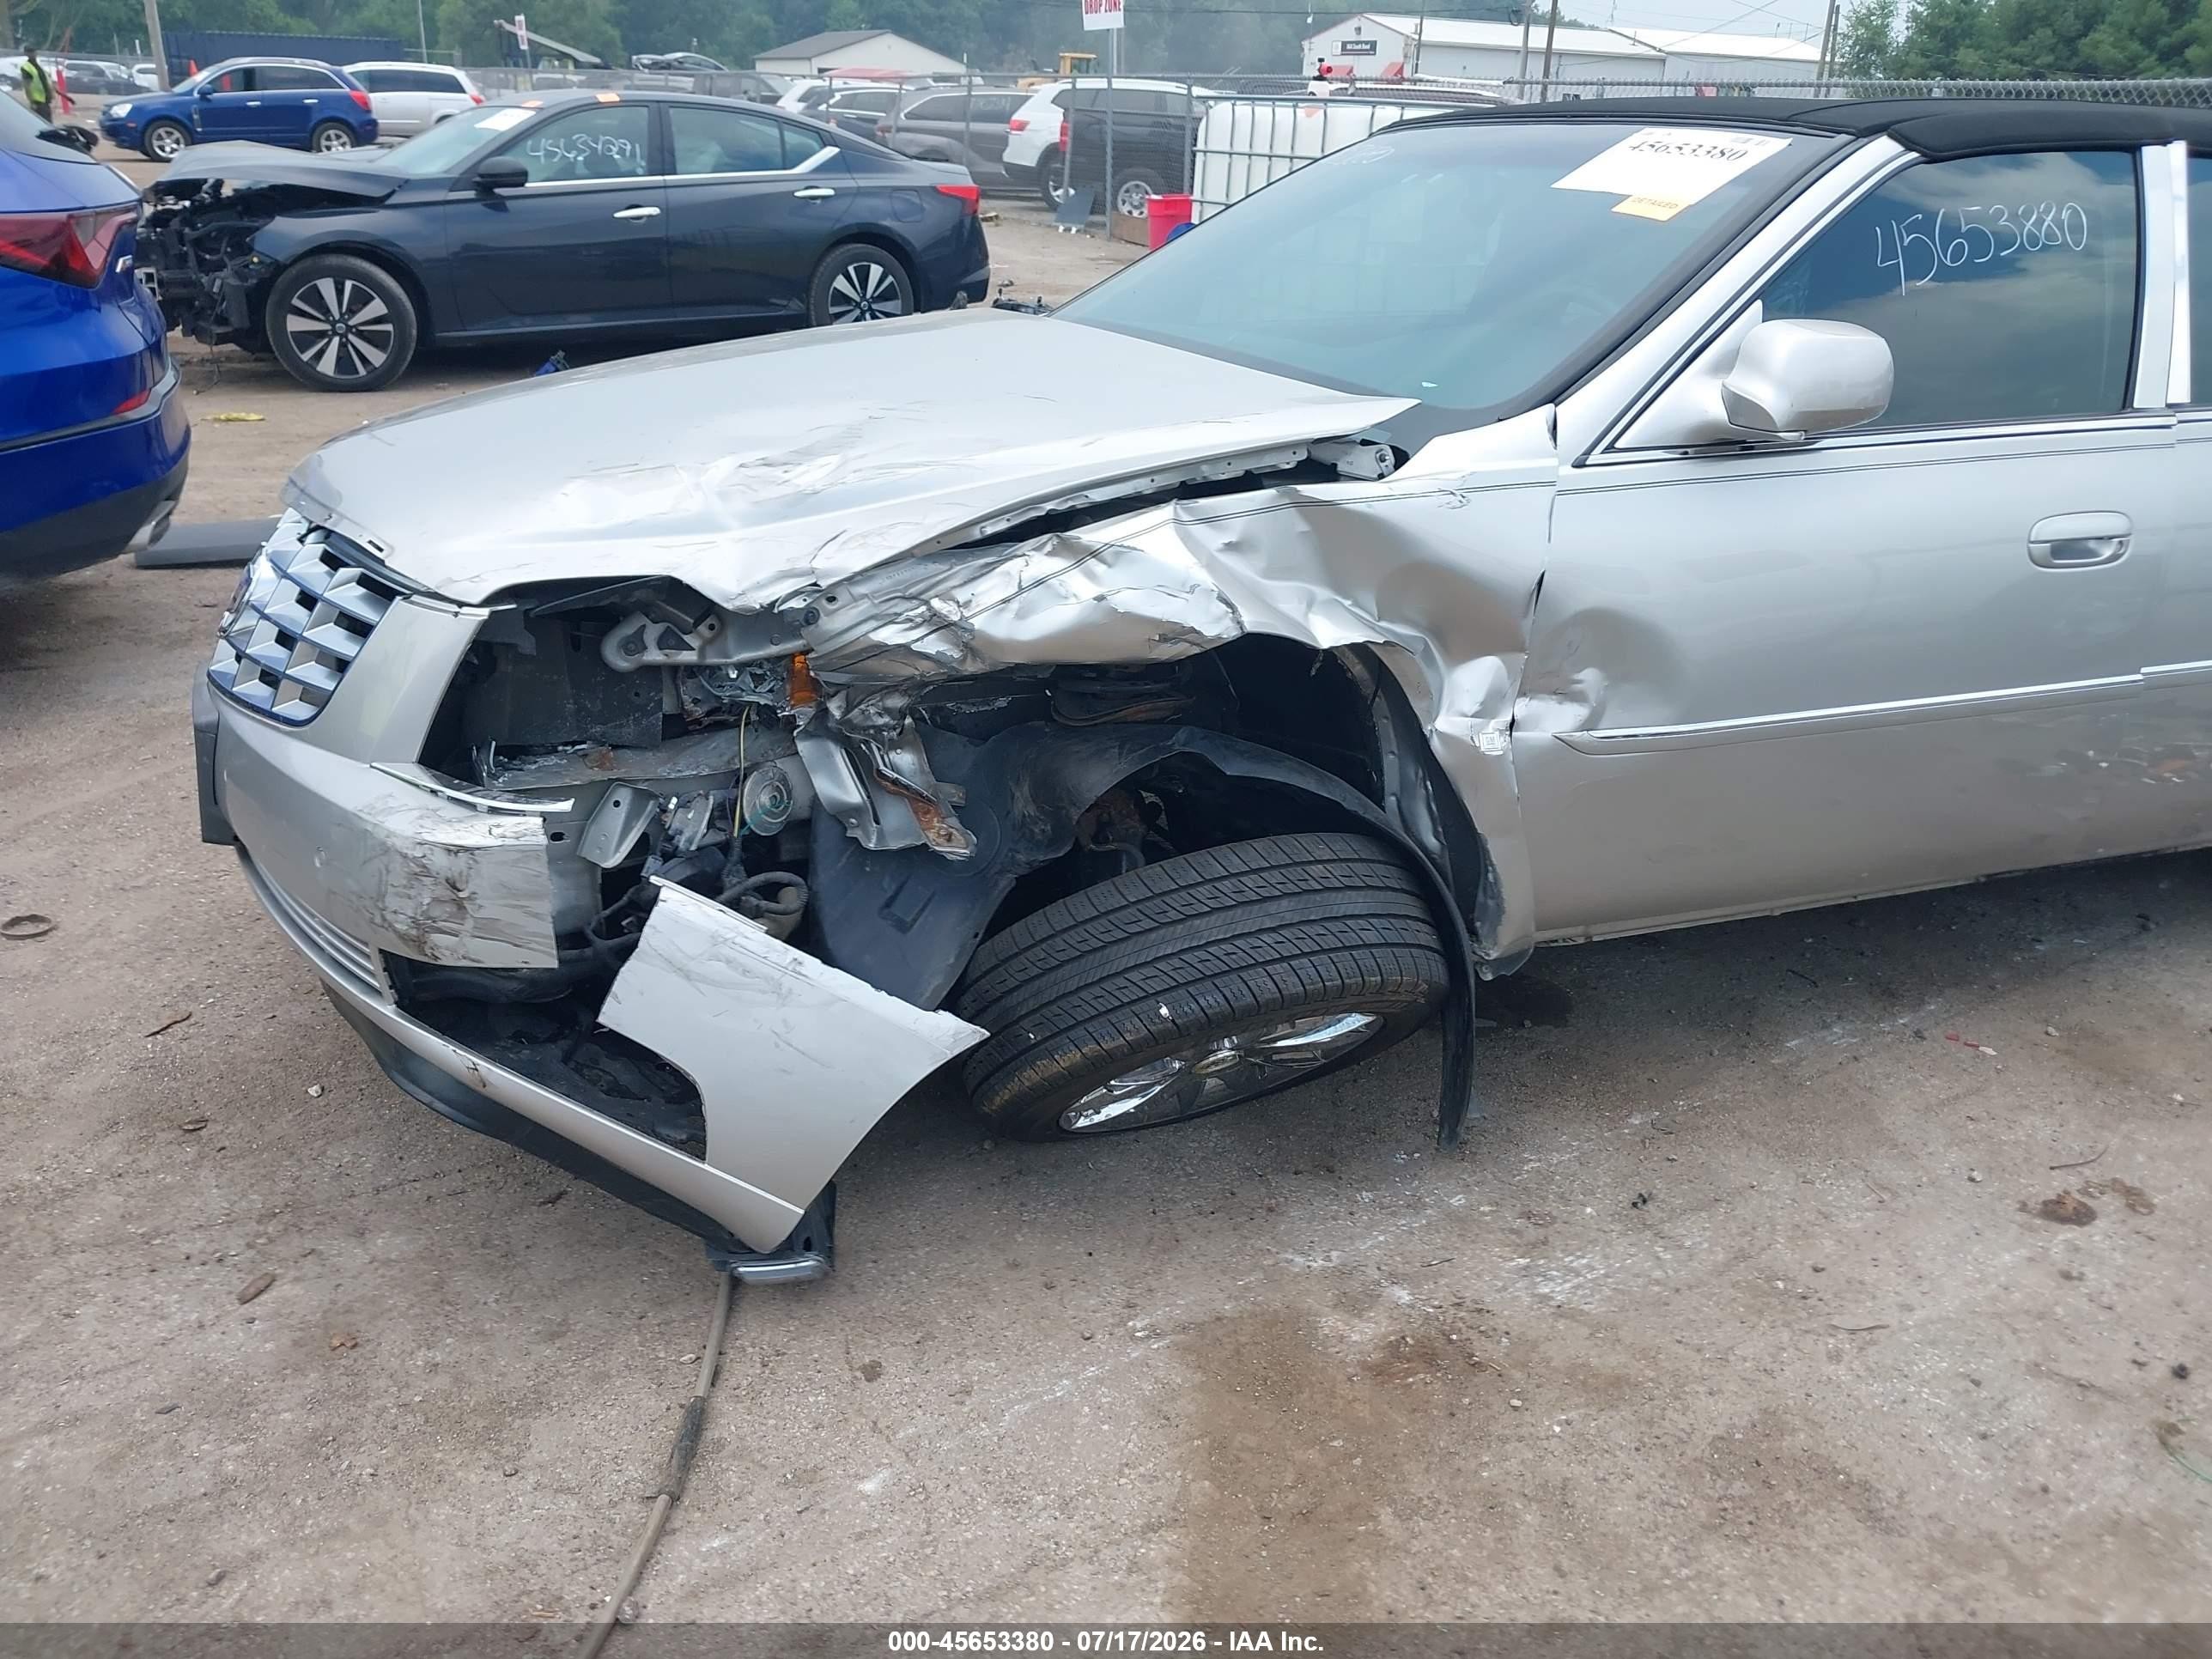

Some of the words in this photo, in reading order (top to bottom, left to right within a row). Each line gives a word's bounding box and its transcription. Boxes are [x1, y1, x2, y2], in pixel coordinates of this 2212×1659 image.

[1085, 0, 1103, 15] DROP
[1628, 140, 1749, 161] 45653380
[1875, 200, 2087, 296] 45653880
